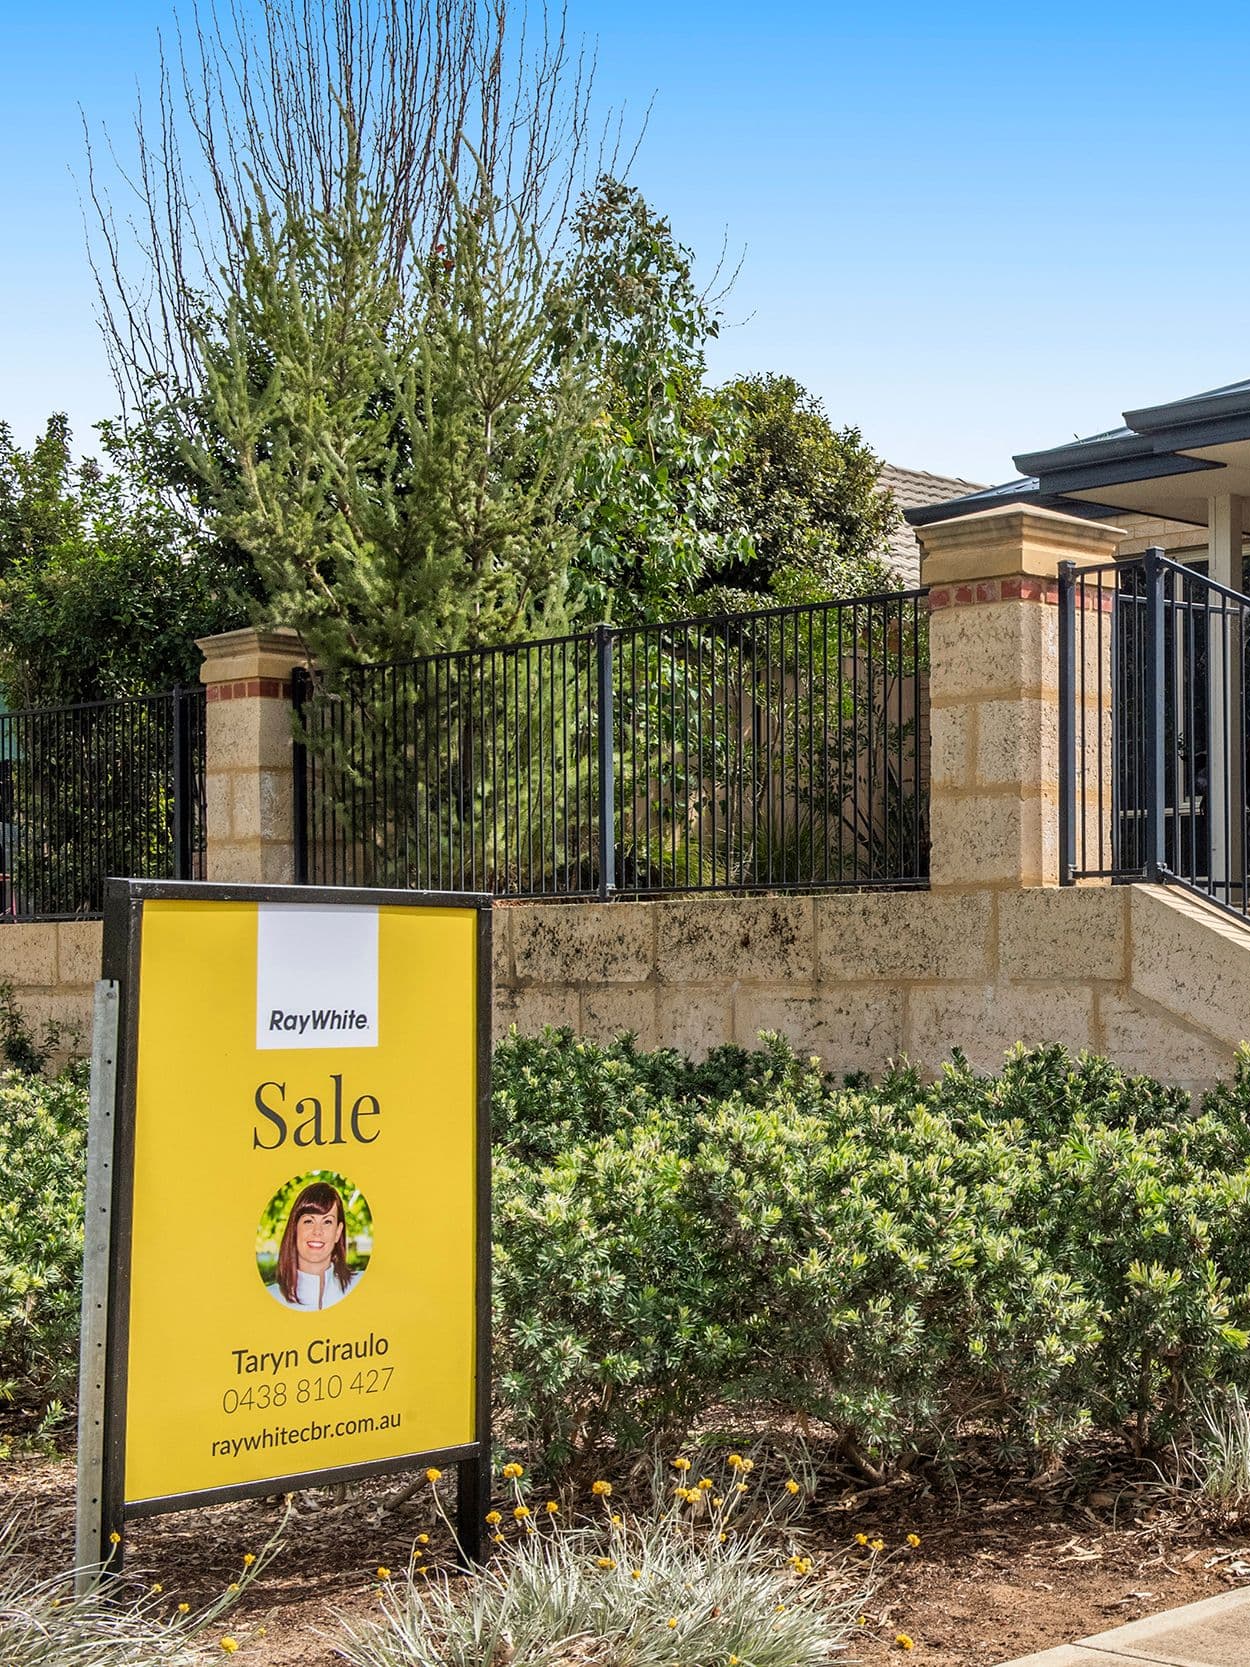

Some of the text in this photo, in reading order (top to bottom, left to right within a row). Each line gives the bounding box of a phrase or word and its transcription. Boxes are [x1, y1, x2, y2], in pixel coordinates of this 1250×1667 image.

[253, 1074, 381, 1151] Sale
[232, 1333, 389, 1375] Taryn Ciraulo
[223, 1367, 395, 1414] 0438 810 427
[212, 1413, 401, 1457] raywhitecbr.com.au
